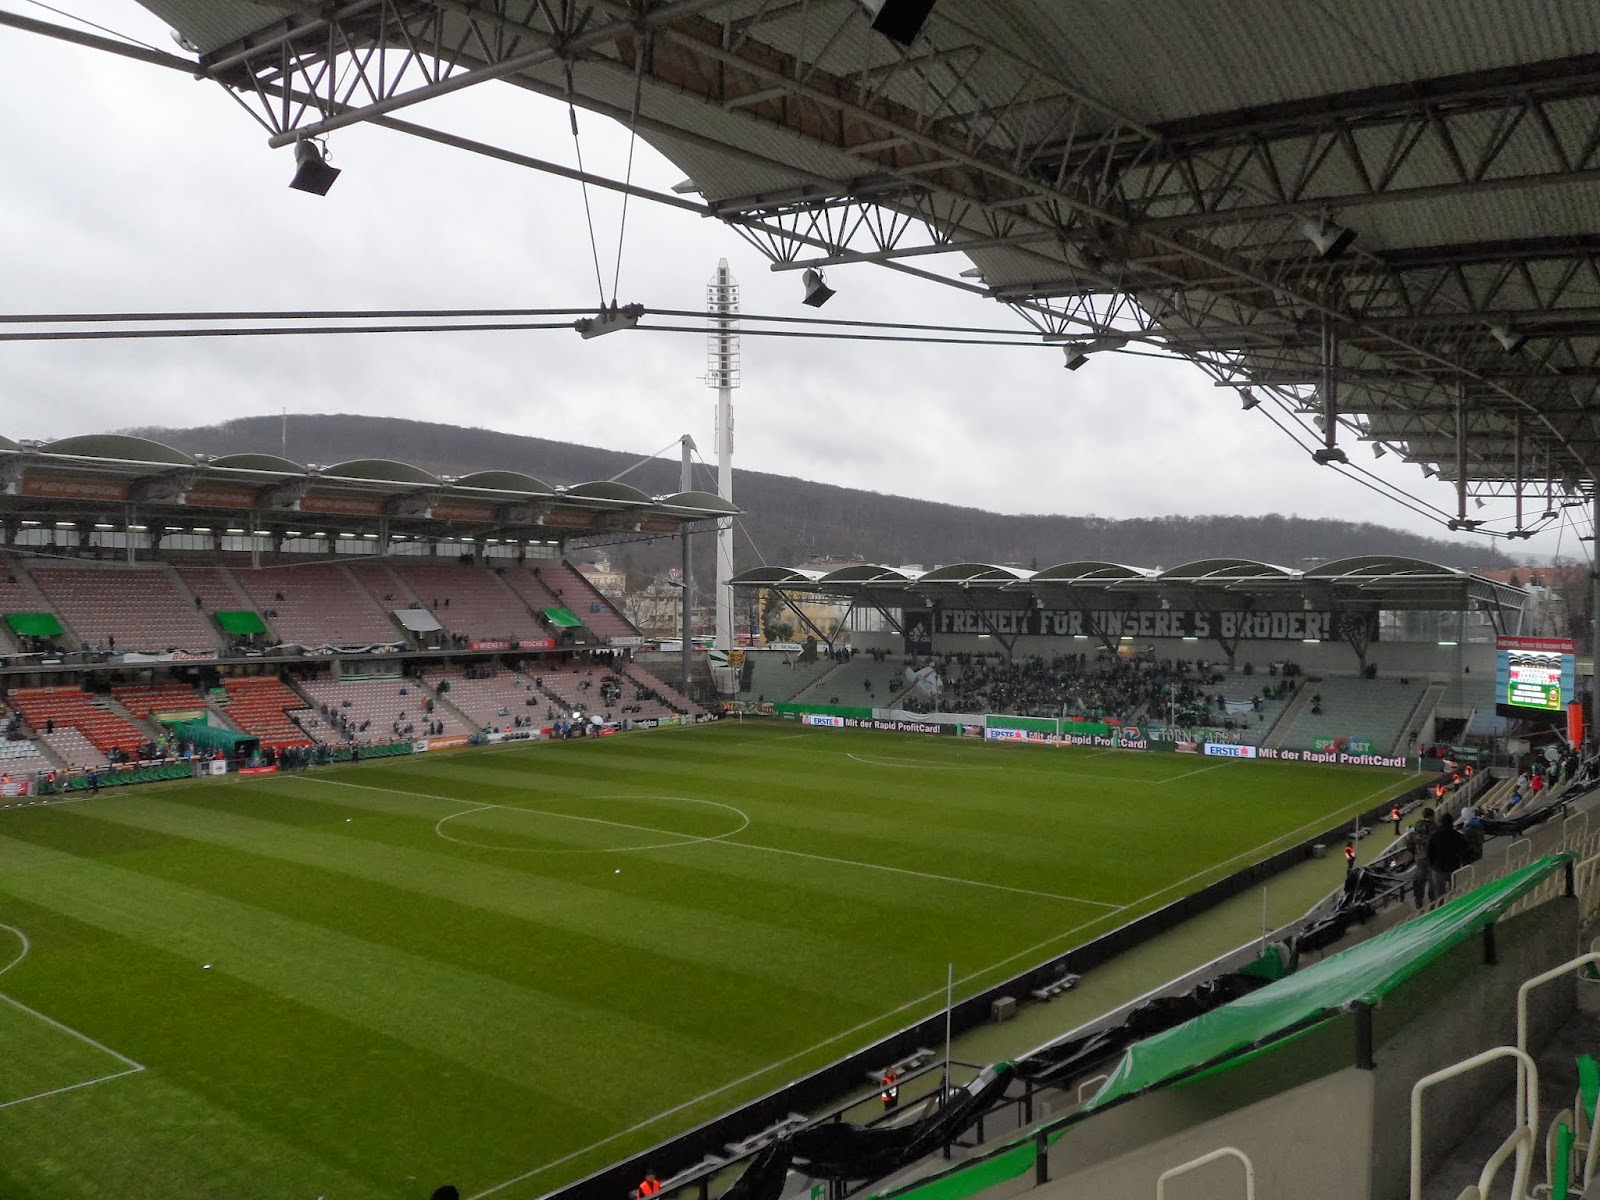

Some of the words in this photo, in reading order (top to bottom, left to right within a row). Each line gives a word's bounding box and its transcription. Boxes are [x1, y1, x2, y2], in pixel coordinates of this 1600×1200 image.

[941, 610, 1032, 634] FREIHEIT
[1040, 610, 1083, 635] FÜR
[1091, 610, 1185, 637] UNSERE
[1221, 611, 1331, 640] BRÜDER!
[845, 718, 858, 727] Mit
[860, 720, 872, 729] der
[874, 720, 896, 731] Rapid
[898, 721, 941, 734] ProfitCard!
[991, 730, 1014, 738] ERSTE
[1029, 731, 1044, 740] Mit
[1065, 735, 1092, 746] Rapid
[1094, 737, 1147, 749] ProftCard!
[1210, 746, 1240, 756] ERSTE
[1258, 747, 1278, 759] Mit
[1281, 750, 1299, 760] der
[1303, 750, 1337, 763] Rapid
[1340, 752, 1406, 768] ProfitCard!
